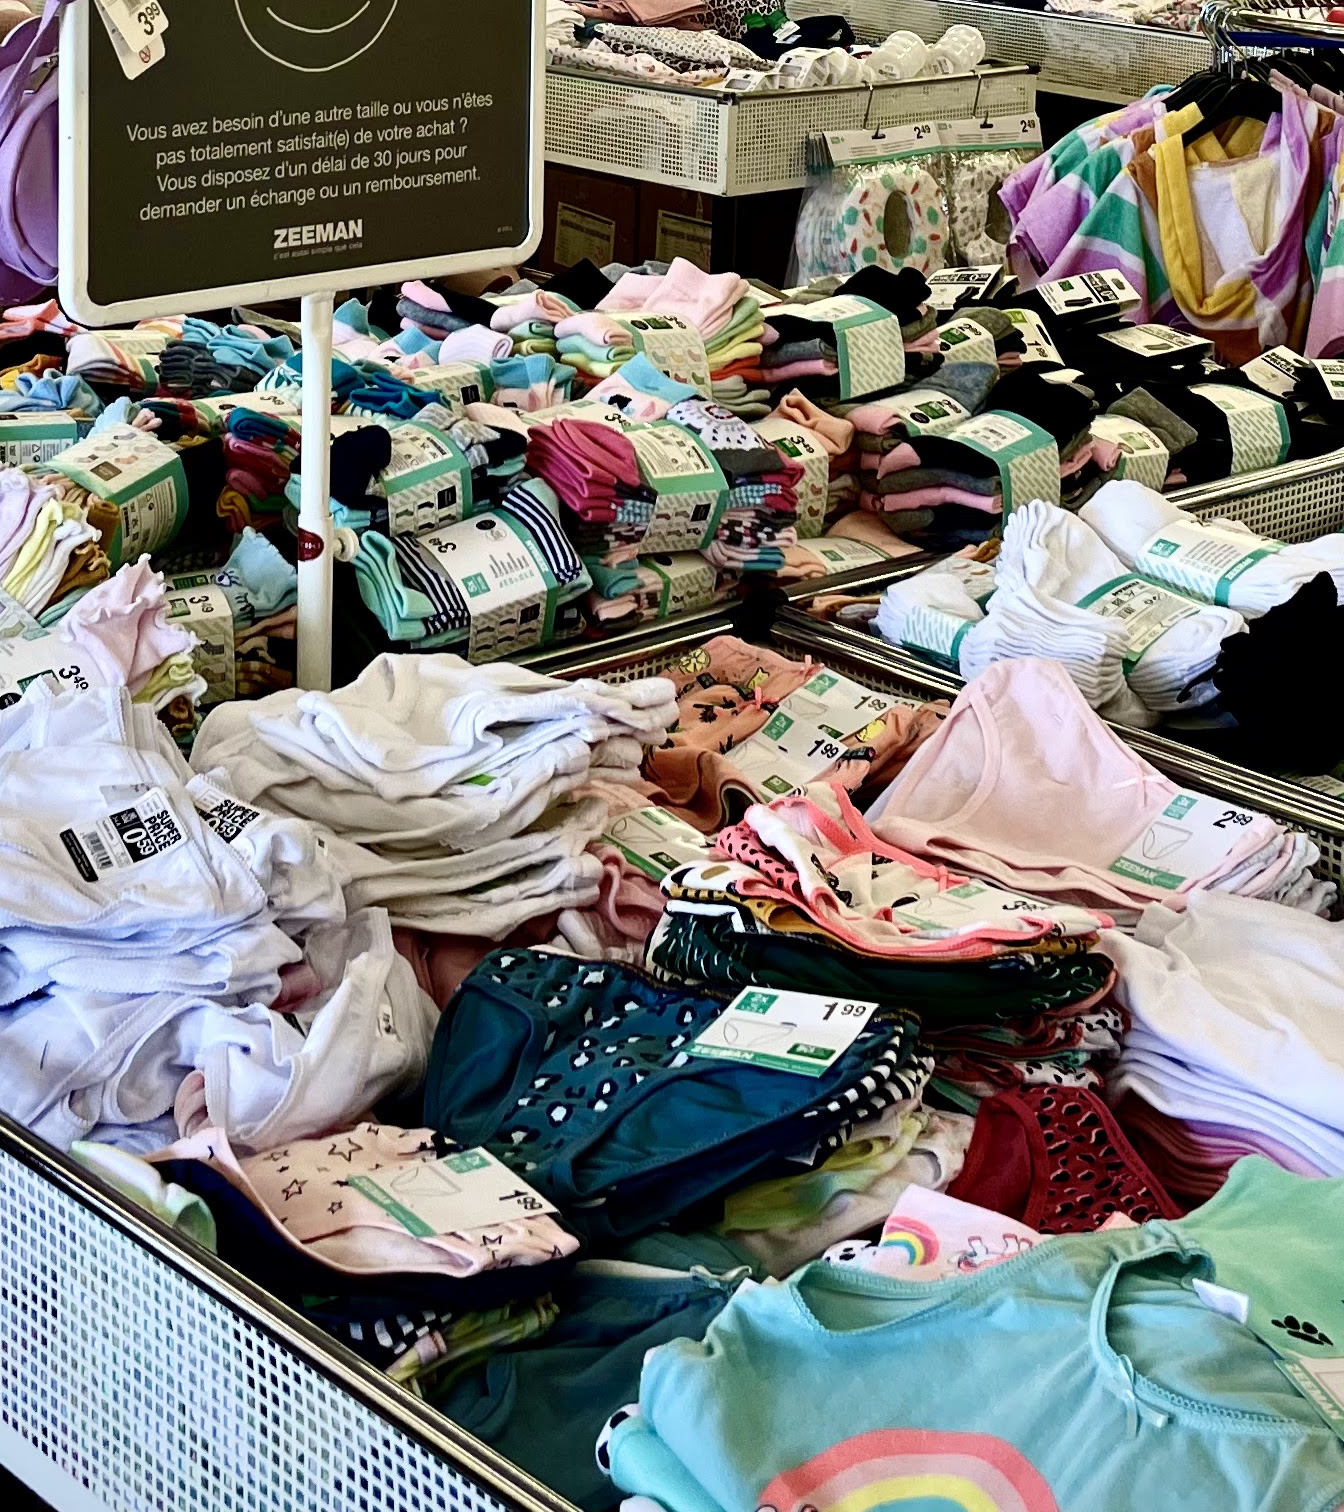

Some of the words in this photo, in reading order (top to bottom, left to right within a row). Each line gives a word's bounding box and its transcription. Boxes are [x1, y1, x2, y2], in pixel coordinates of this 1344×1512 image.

[127, 124, 167, 141] Vous
[171, 120, 208, 138] avez
[212, 113, 264, 133] besoin
[269, 109, 311, 128] d'une
[315, 106, 352, 123] autre
[356, 100, 389, 119] taille
[393, 101, 412, 115] ou
[416, 98, 449, 113] vous
[453, 92, 493, 109] n'êtes
[156, 150, 186, 169] pas
[191, 137, 272, 161] totalement
[277, 128, 350, 153] satisfait(e)
[354, 128, 373, 144] de
[376, 125, 412, 142] votre
[416, 119, 455, 138] achat
[459, 117, 468, 134] ?
[157, 174, 196, 192] Vous
[201, 168, 270, 191] disposez
[275, 162, 307, 180] d'un
[312, 155, 347, 175] délai
[351, 153, 370, 170] de
[373, 150, 392, 168] 30
[396, 147, 430, 167] jours
[435, 143, 468, 164] pour
[139, 198, 220, 222] demander
[227, 195, 245, 211] un
[250, 186, 315, 210] échange
[320, 185, 339, 199] ou
[343, 181, 361, 196] un
[365, 166, 481, 195] remboursement.
[274, 219, 362, 248] ZEEMAN
[807, 739, 839, 759] 199
[157, 809, 182, 847] SUPER
[221, 799, 260, 823] SUPER
[1213, 810, 1253, 829] 299
[144, 816, 170, 852] PRICE
[823, 1002, 866, 1021] 199
[1285, 1364, 1344, 1421] ZEEMAN
